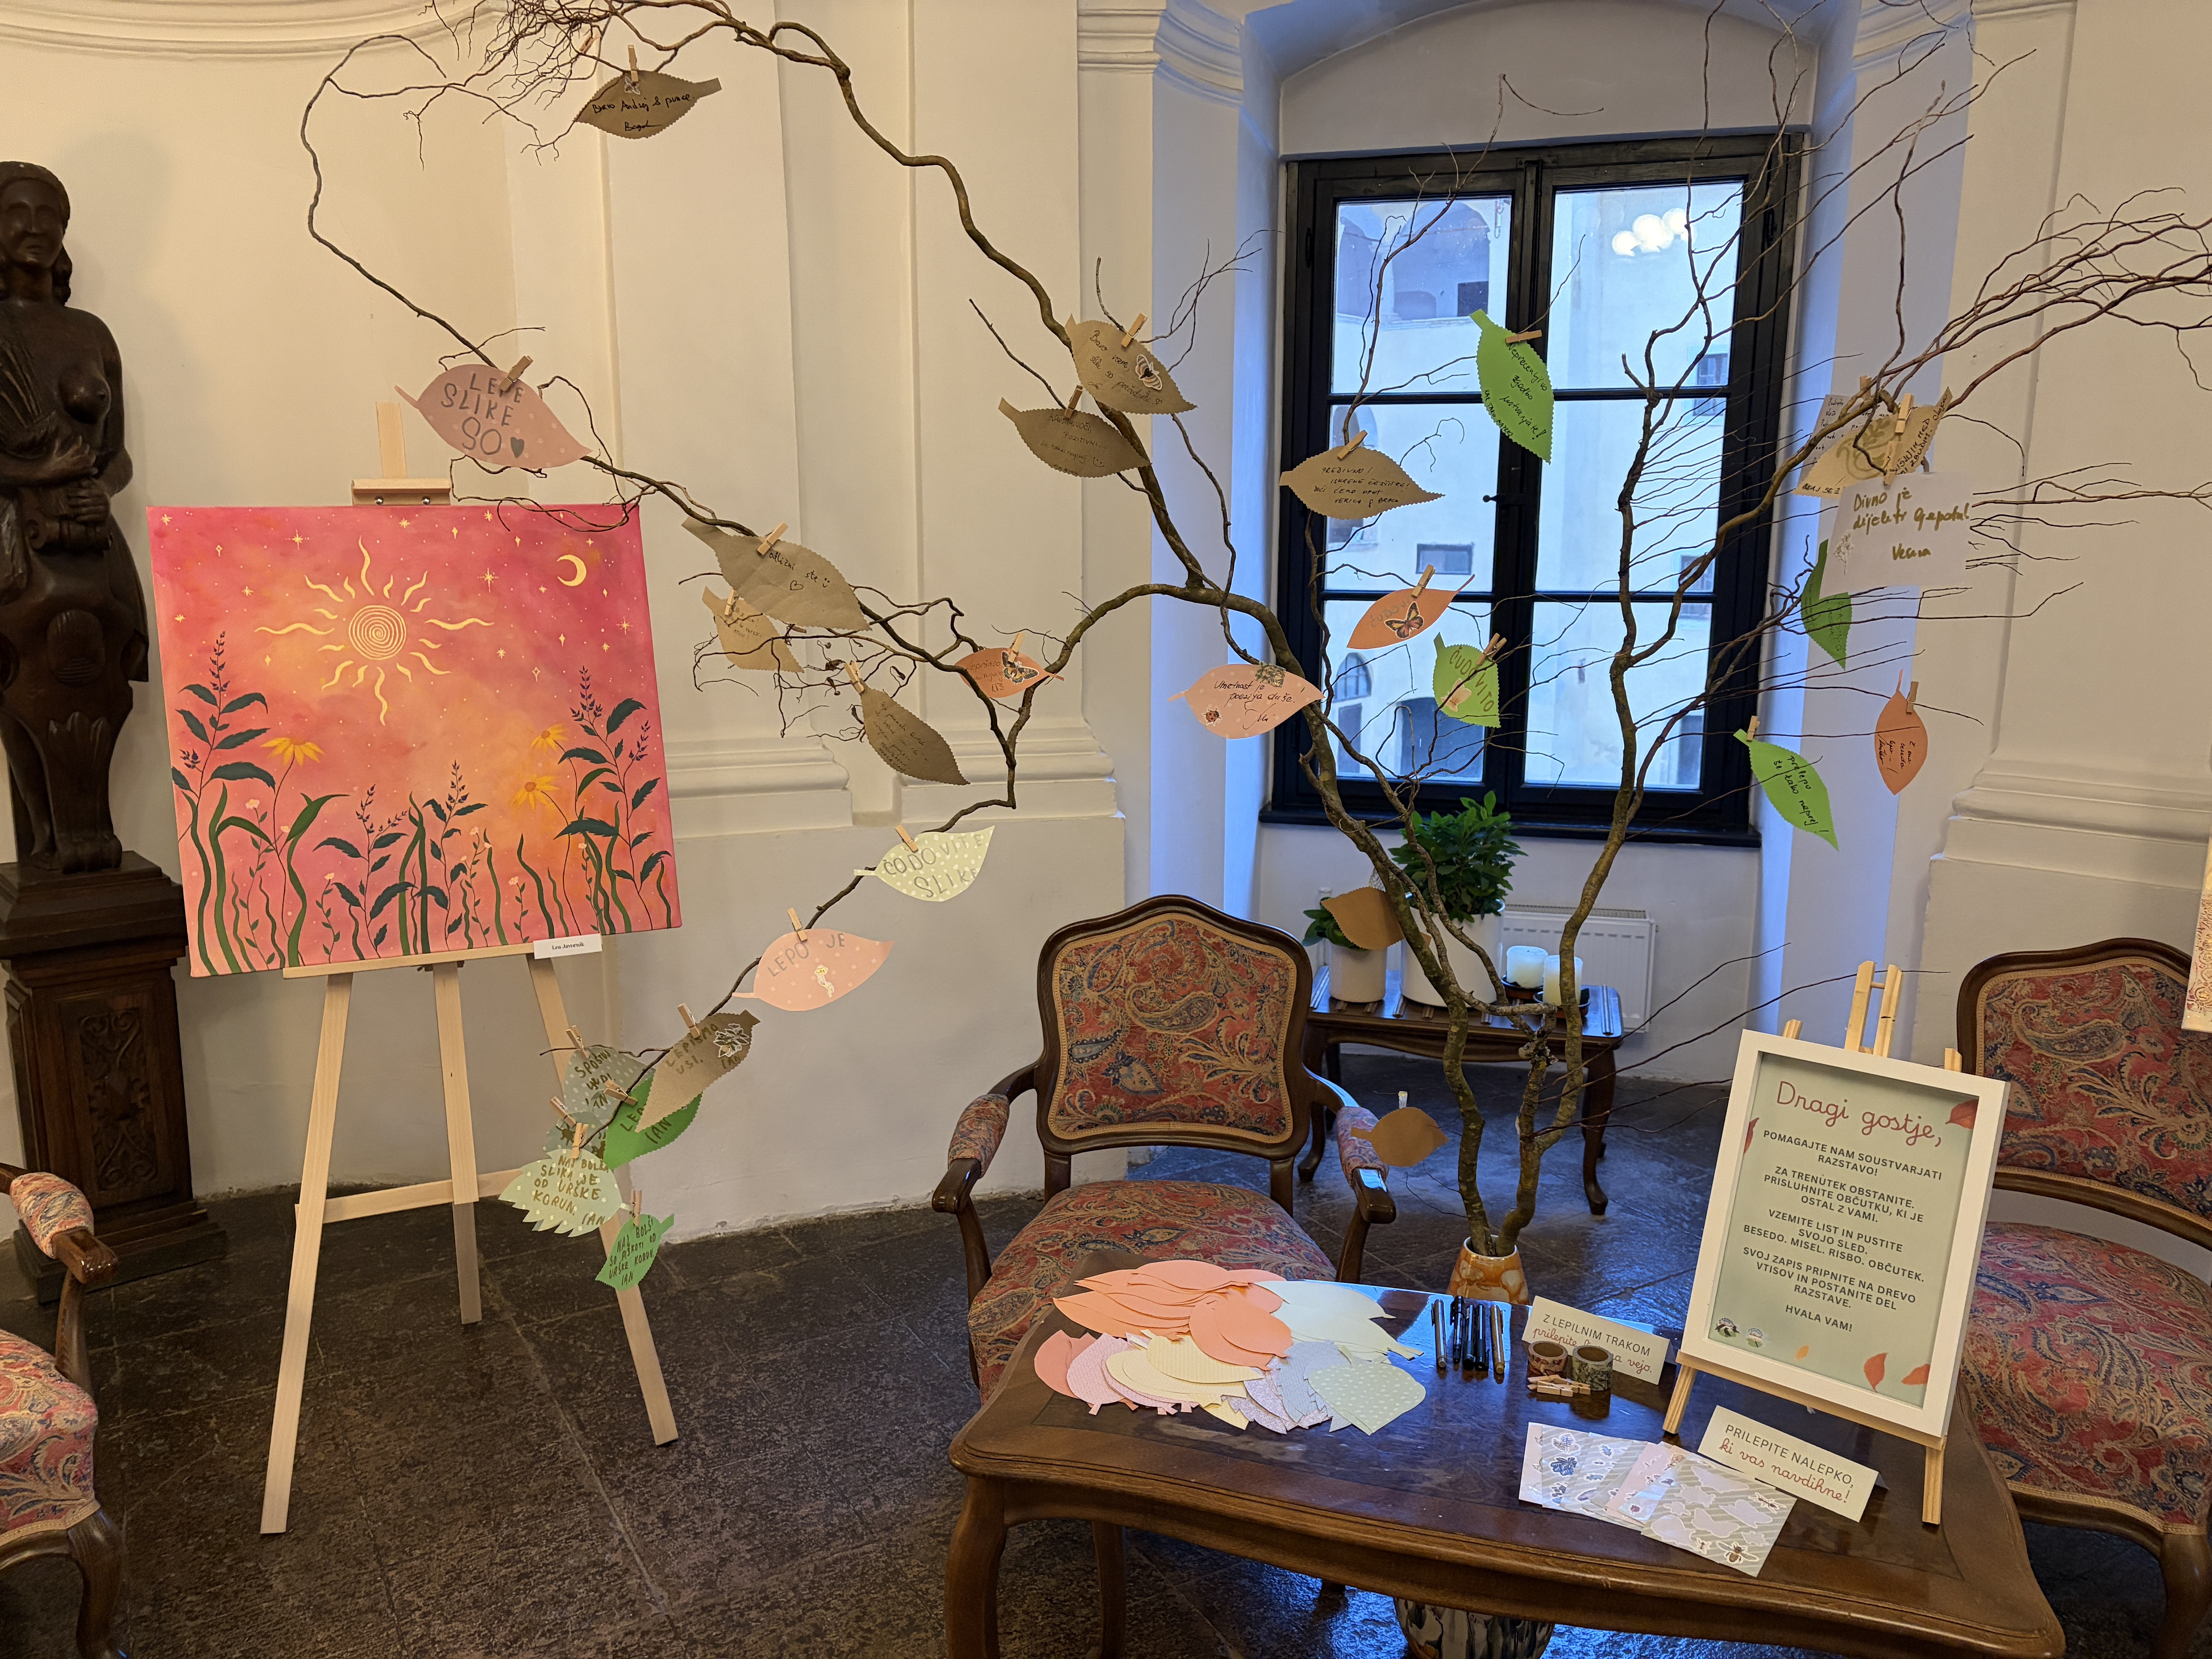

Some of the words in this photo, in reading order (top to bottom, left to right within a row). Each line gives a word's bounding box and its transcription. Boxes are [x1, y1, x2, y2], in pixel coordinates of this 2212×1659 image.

[1089, 330, 1108, 351] Bravo
[1510, 375, 1533, 400] zgodbo
[441, 383, 514, 426] SLIKE
[1499, 396, 1547, 440] ustvarjate!
[462, 417, 502, 455] SO
[1854, 492, 1888, 511] Divno
[769, 551, 795, 570] odlični
[805, 570, 818, 582] ste
[1214, 680, 1254, 690] Umetnost
[1224, 692, 1262, 708] poezija
[1267, 693, 1295, 703] duše.
[1784, 775, 1799, 794] tako
[1787, 756, 1811, 790] prlepo
[914, 869, 977, 898] SLIKE
[767, 942, 810, 977] LEPO
[826, 933, 845, 948] JE
[677, 1057, 703, 1074] USI.
[1777, 1081, 1849, 1127] Dragi
[1862, 1111, 1941, 1147] gostje,
[645, 1116, 672, 1144] IAN
[558, 1155, 575, 1168] NAJ
[1764, 1130, 1827, 1152] POMAGAJTE
[1830, 1147, 1855, 1159] NAM
[1858, 1153, 1942, 1180] SOUSTVARJATI
[1818, 1154, 1878, 1176] RAZSTAVO!
[534, 1178, 548, 1188] OD
[558, 1179, 601, 1200] URŠKE
[541, 1164, 573, 1182] SLIKA
[576, 1174, 599, 1186] JE
[1775, 1166, 1788, 1176] ZA
[1850, 1186, 1915, 1209] OBSTANITE.
[534, 1190, 575, 1216] KORUN.
[1764, 1175, 1833, 1199] PRISLUHNITE
[1836, 1191, 1892, 1216] OBČUTKU,
[1896, 1209, 1907, 1218] KI
[1910, 1212, 1924, 1223] JE
[1801, 1195, 1835, 1211] OSTAL
[1837, 1205, 1844, 1213] Z
[1848, 1207, 1878, 1222] VAMI.
[582, 1213, 605, 1226] IAN
[636, 1215, 653, 1238] BOLŠI
[1769, 1209, 1813, 1228] VZEMITE
[1816, 1222, 1839, 1235] LIST
[1842, 1228, 1853, 1238] IN
[1857, 1233, 1903, 1252] PUSTITE
[609, 1255, 617, 1267] SO
[649, 1233, 656, 1243] OD
[1744, 1224, 1787, 1243] BESEDO.
[1791, 1238, 1825, 1254] MISEL.
[1829, 1249, 1864, 1265] RISBO.
[1869, 1259, 1924, 1282] OBČUTEK.
[1798, 1229, 1834, 1244] SVOJO
[1837, 1238, 1868, 1254] SLED.
[609, 1261, 628, 1279] URŠKE
[622, 1273, 634, 1286] IAN
[1743, 1247, 1769, 1261] SVOJ
[1772, 1255, 1803, 1270] ZAPIS
[1806, 1264, 1855, 1286] PRIPNITE
[1858, 1280, 1874, 1291] NA
[1877, 1285, 1915, 1303] DREVO
[1757, 1261, 1794, 1279] VTISOV
[1797, 1273, 1808, 1283] IN
[1812, 1278, 1873, 1303] POSTANITE
[1876, 1297, 1897, 1310] DEL
[1794, 1284, 1851, 1308] RAZSTAVE.
[1786, 1304, 1821, 1322] HVALA
[1825, 1316, 1852, 1331] VAM!
[1543, 1314, 1550, 1323] Z
[1553, 1317, 1602, 1340] LEPILNIM
[1606, 1334, 1650, 1356] TRAKOM
[1533, 1327, 1577, 1347] prilepite
[1628, 1359, 1652, 1374] vejo.
[1726, 1424, 1789, 1458] PRILEPITE
[1791, 1452, 1854, 1487] NALEPKO,
[1719, 1438, 1734, 1454] ki
[1740, 1450, 1765, 1468] vas
[1771, 1465, 1850, 1503] navdihne!
